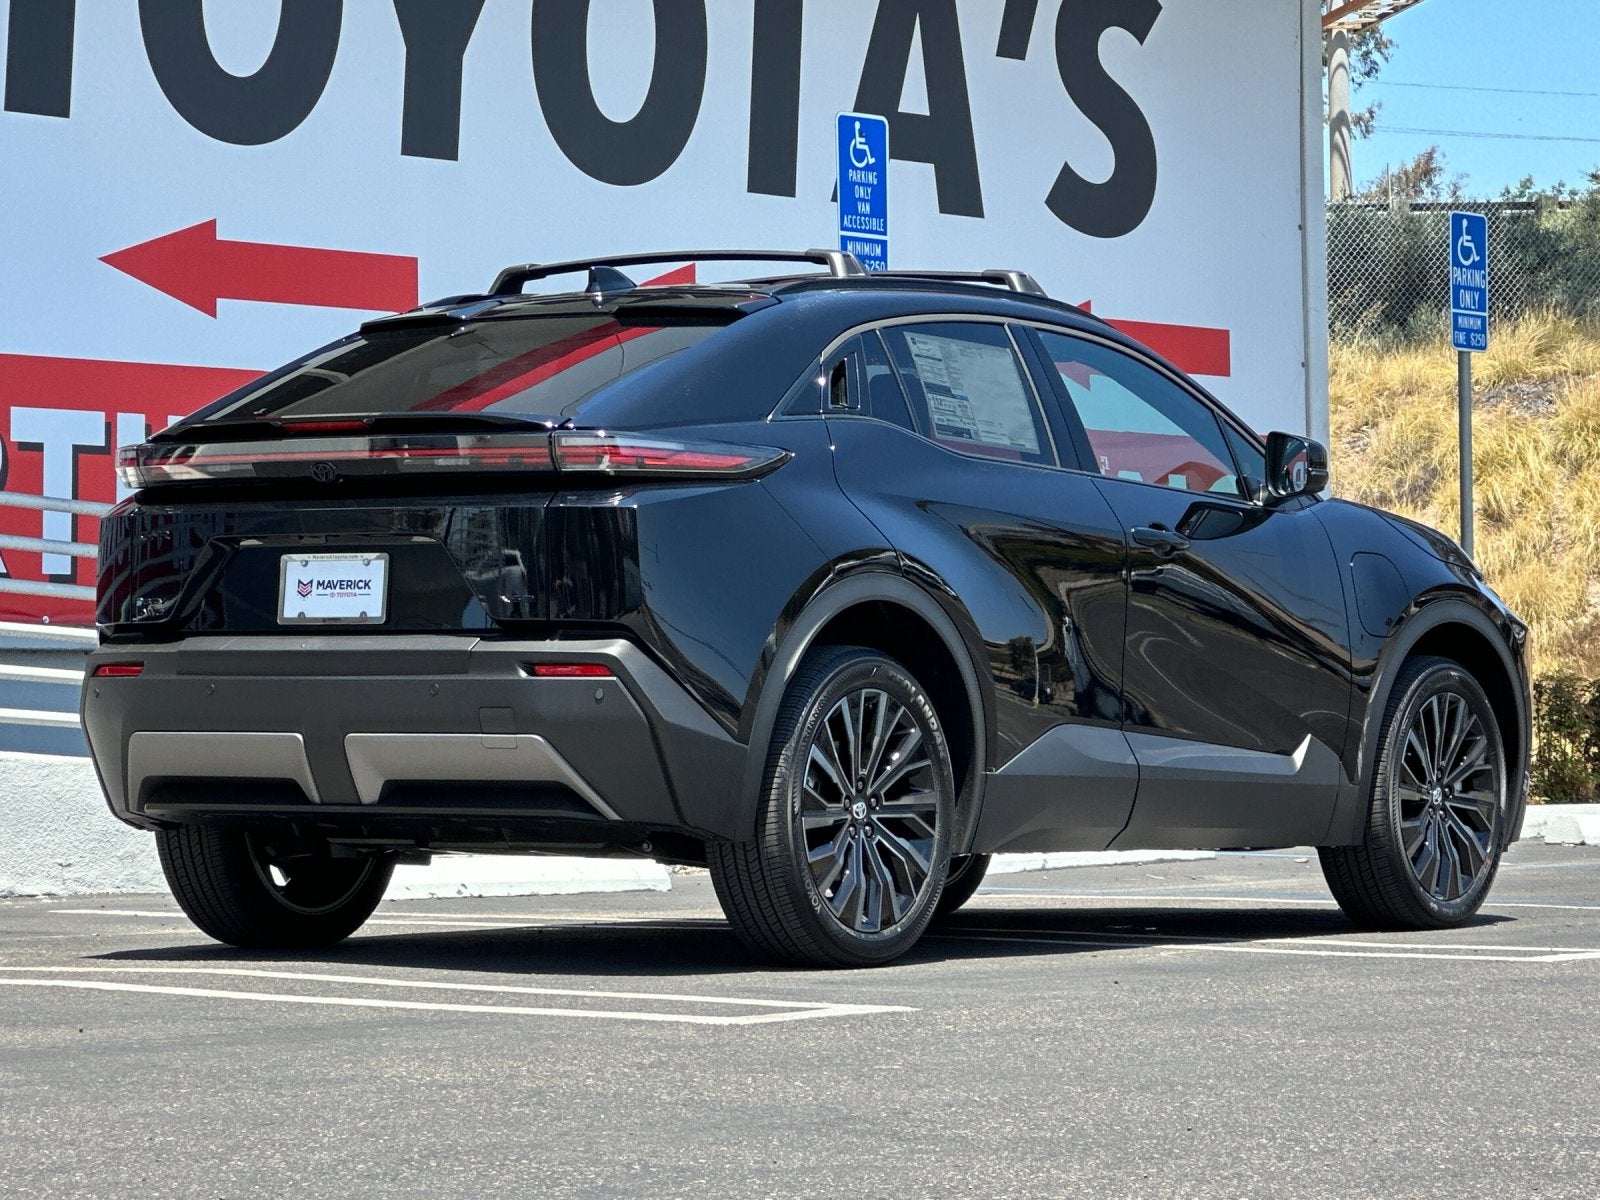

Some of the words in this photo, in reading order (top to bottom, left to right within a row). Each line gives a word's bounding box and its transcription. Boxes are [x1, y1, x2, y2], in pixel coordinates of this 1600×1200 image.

[848, 169, 878, 186] PARKING
[854, 185, 872, 200] ONLY
[857, 201, 871, 215] VAN
[843, 214, 885, 231] ACCESSIBLE
[847, 240, 882, 257] MINIMUM
[1453, 266, 1486, 289] PARKING
[1460, 289, 1480, 310] ONLY
[1458, 315, 1482, 331] MINIMUM
[1454, 331, 1466, 345] FINE
[1470, 332, 1486, 347] $250
[316, 579, 372, 590] MAVERICK
